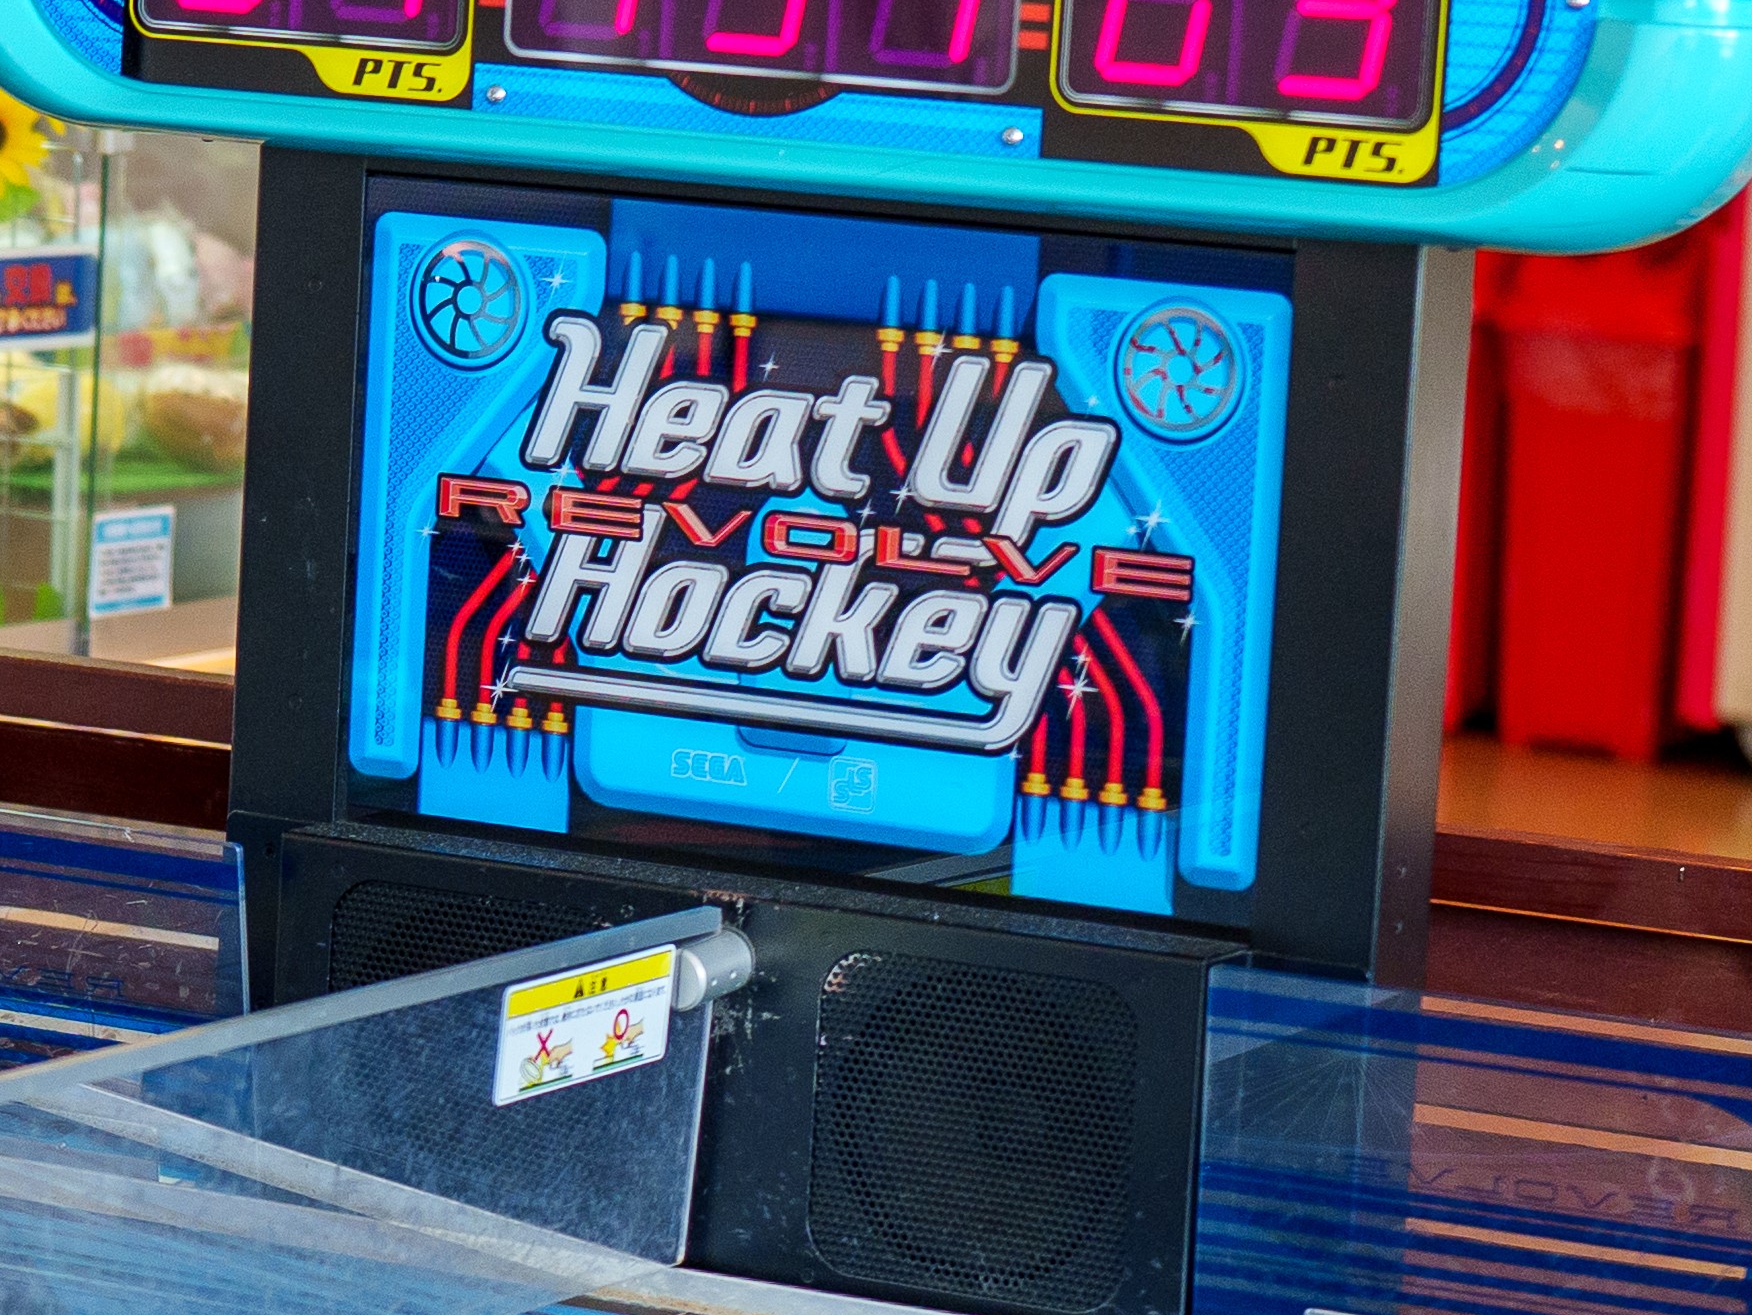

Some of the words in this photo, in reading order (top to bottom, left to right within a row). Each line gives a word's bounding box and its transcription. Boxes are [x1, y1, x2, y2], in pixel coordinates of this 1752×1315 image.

[352, 57, 443, 94] PTS.
[1301, 136, 1406, 175] PTS.
[522, 308, 893, 501] Heat
[907, 353, 1122, 538] Up
[434, 472, 1196, 603] REVOLVE
[510, 504, 1084, 753] Hockey
[670, 747, 748, 787] SEGA
